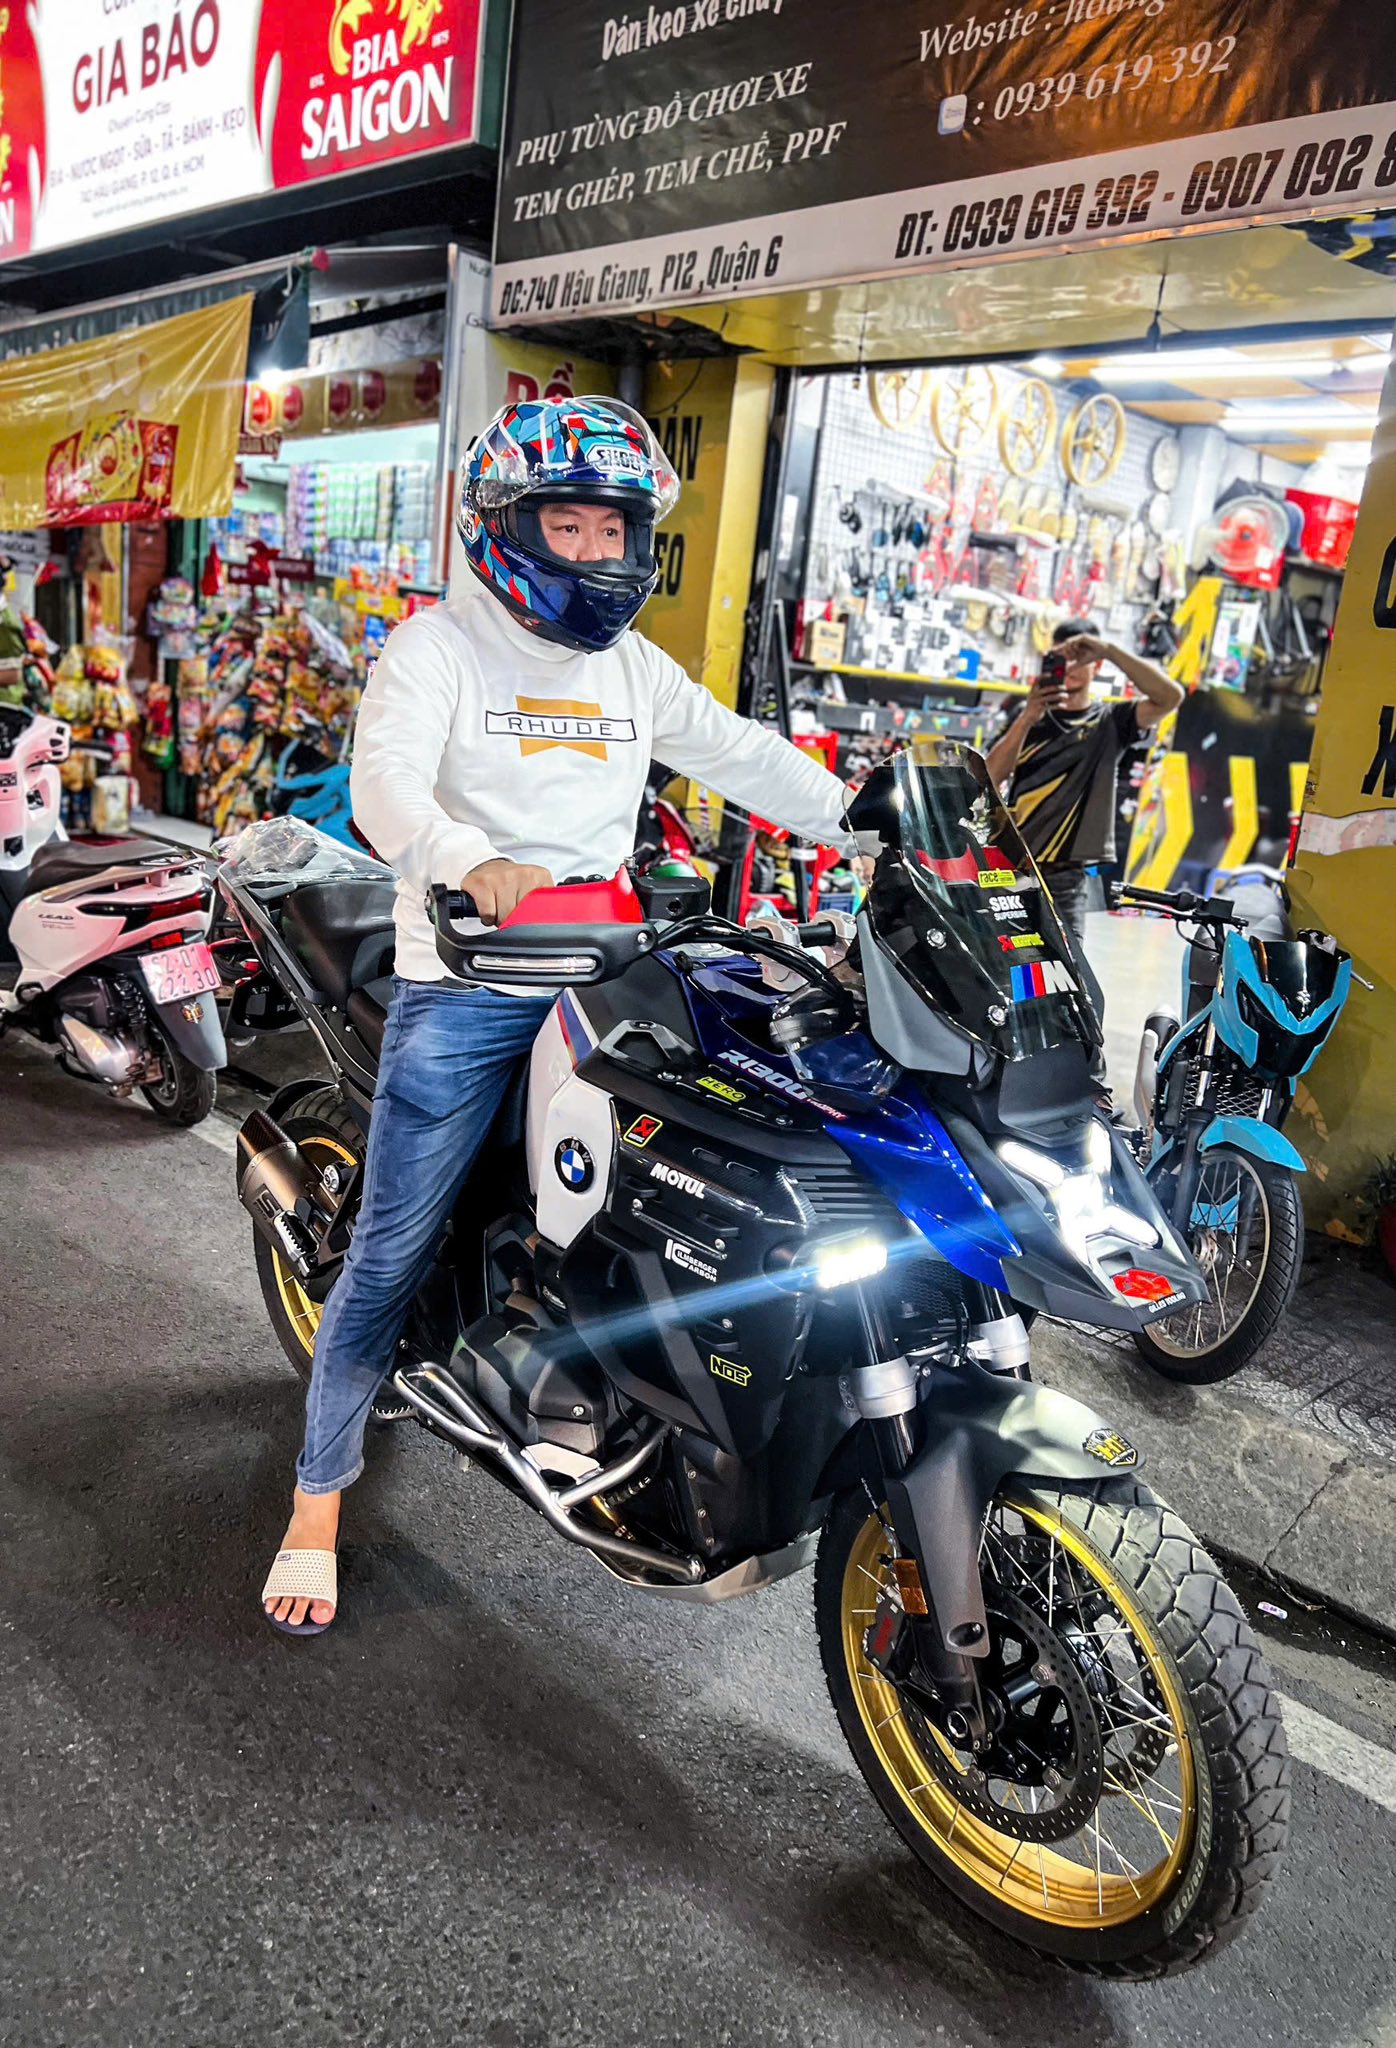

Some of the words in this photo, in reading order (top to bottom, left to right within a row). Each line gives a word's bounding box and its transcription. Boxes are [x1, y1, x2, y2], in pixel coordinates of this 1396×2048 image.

[352, 28, 400, 80] BIA
[602, 14, 641, 61] Dán
[646, 5, 686, 47] keo
[919, 7, 1038, 62] Website
[73, 37, 129, 114] GIA
[993, 71, 1075, 120] 0939
[1085, 53, 1154, 101] 619
[1163, 35, 1237, 84] 392
[301, 55, 455, 160] SAIGON
[515, 130, 567, 167] PHỤ
[570, 111, 639, 154] TÙNG
[687, 74, 765, 122] CHƠI
[765, 62, 814, 102] XE
[513, 187, 562, 222] TEM
[565, 166, 635, 212] GHÉP,
[644, 154, 702, 195] TEM
[706, 130, 774, 181] CHẾ,
[782, 121, 848, 164] PPF
[942, 193, 1023, 252] 0939
[1024, 182, 1085, 240] 619
[1085, 169, 1159, 230] 392
[1180, 148, 1285, 215] 0907
[1283, 134, 1374, 200] 092
[560, 269, 595, 313] Hậu
[598, 263, 653, 303] Giang,
[660, 250, 698, 293] P12
[764, 235, 784, 278] 6
[508, 716, 613, 736] RHUDE
[702, 1076, 746, 1100] HERO
[559, 1140, 591, 1164] BMW
[649, 1162, 708, 1200] MOTUL
[712, 1355, 746, 1385] NOS
